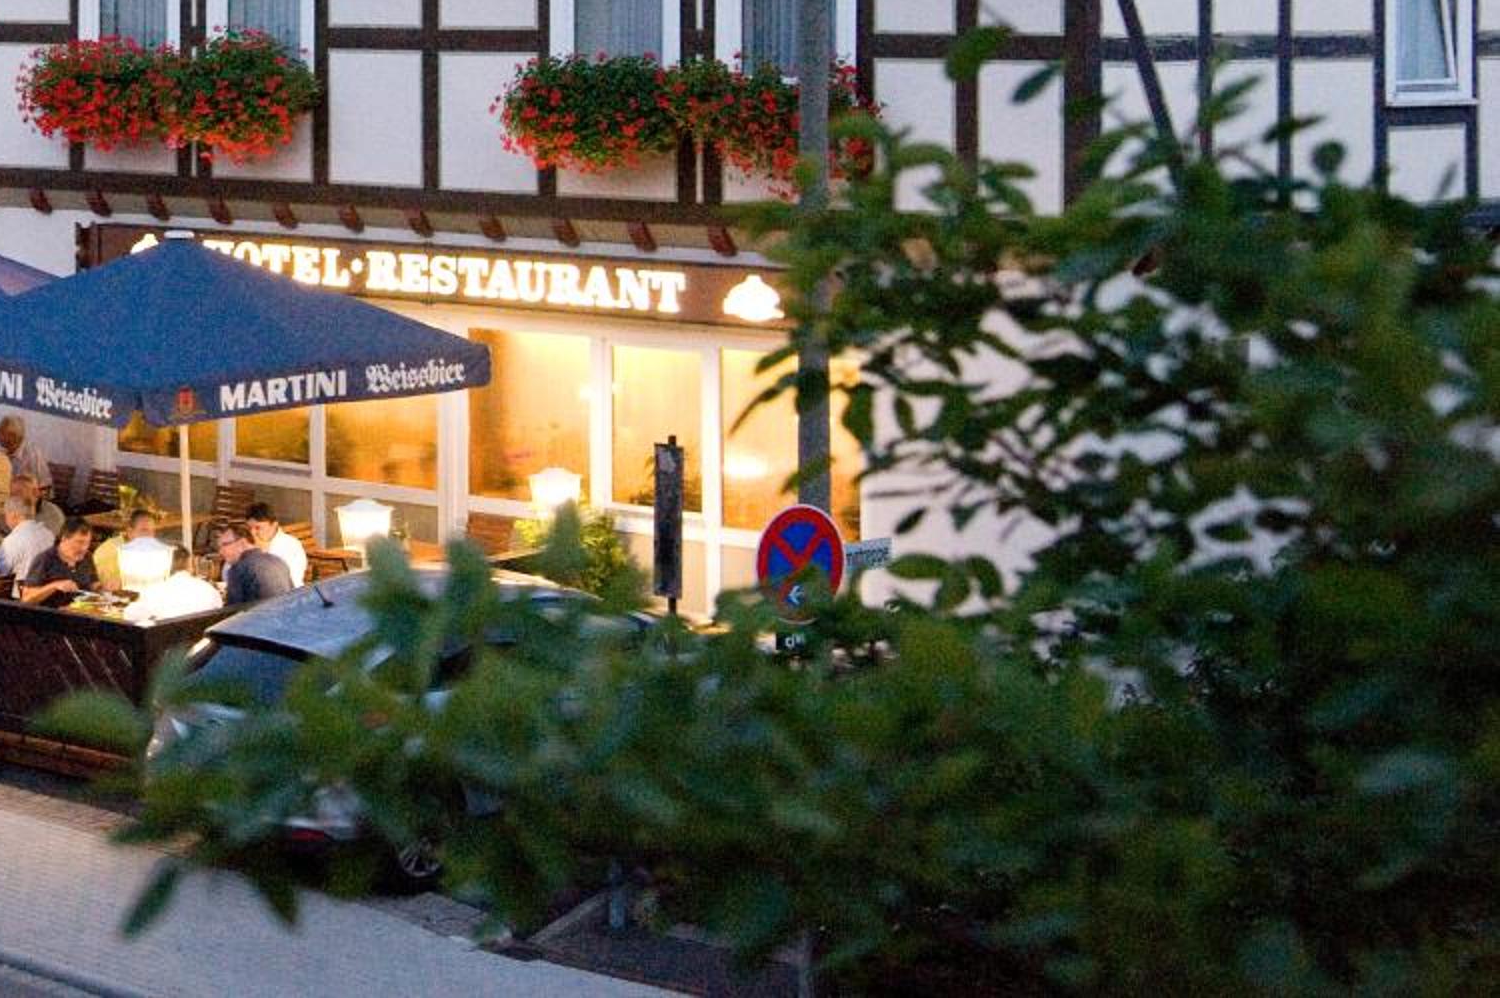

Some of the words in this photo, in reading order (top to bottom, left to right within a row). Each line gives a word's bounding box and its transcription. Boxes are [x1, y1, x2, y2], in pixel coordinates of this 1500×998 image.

[365, 250, 687, 313] RESTAURANT
[219, 369, 348, 412] MARTINI
[365, 358, 466, 393] Weissbier
